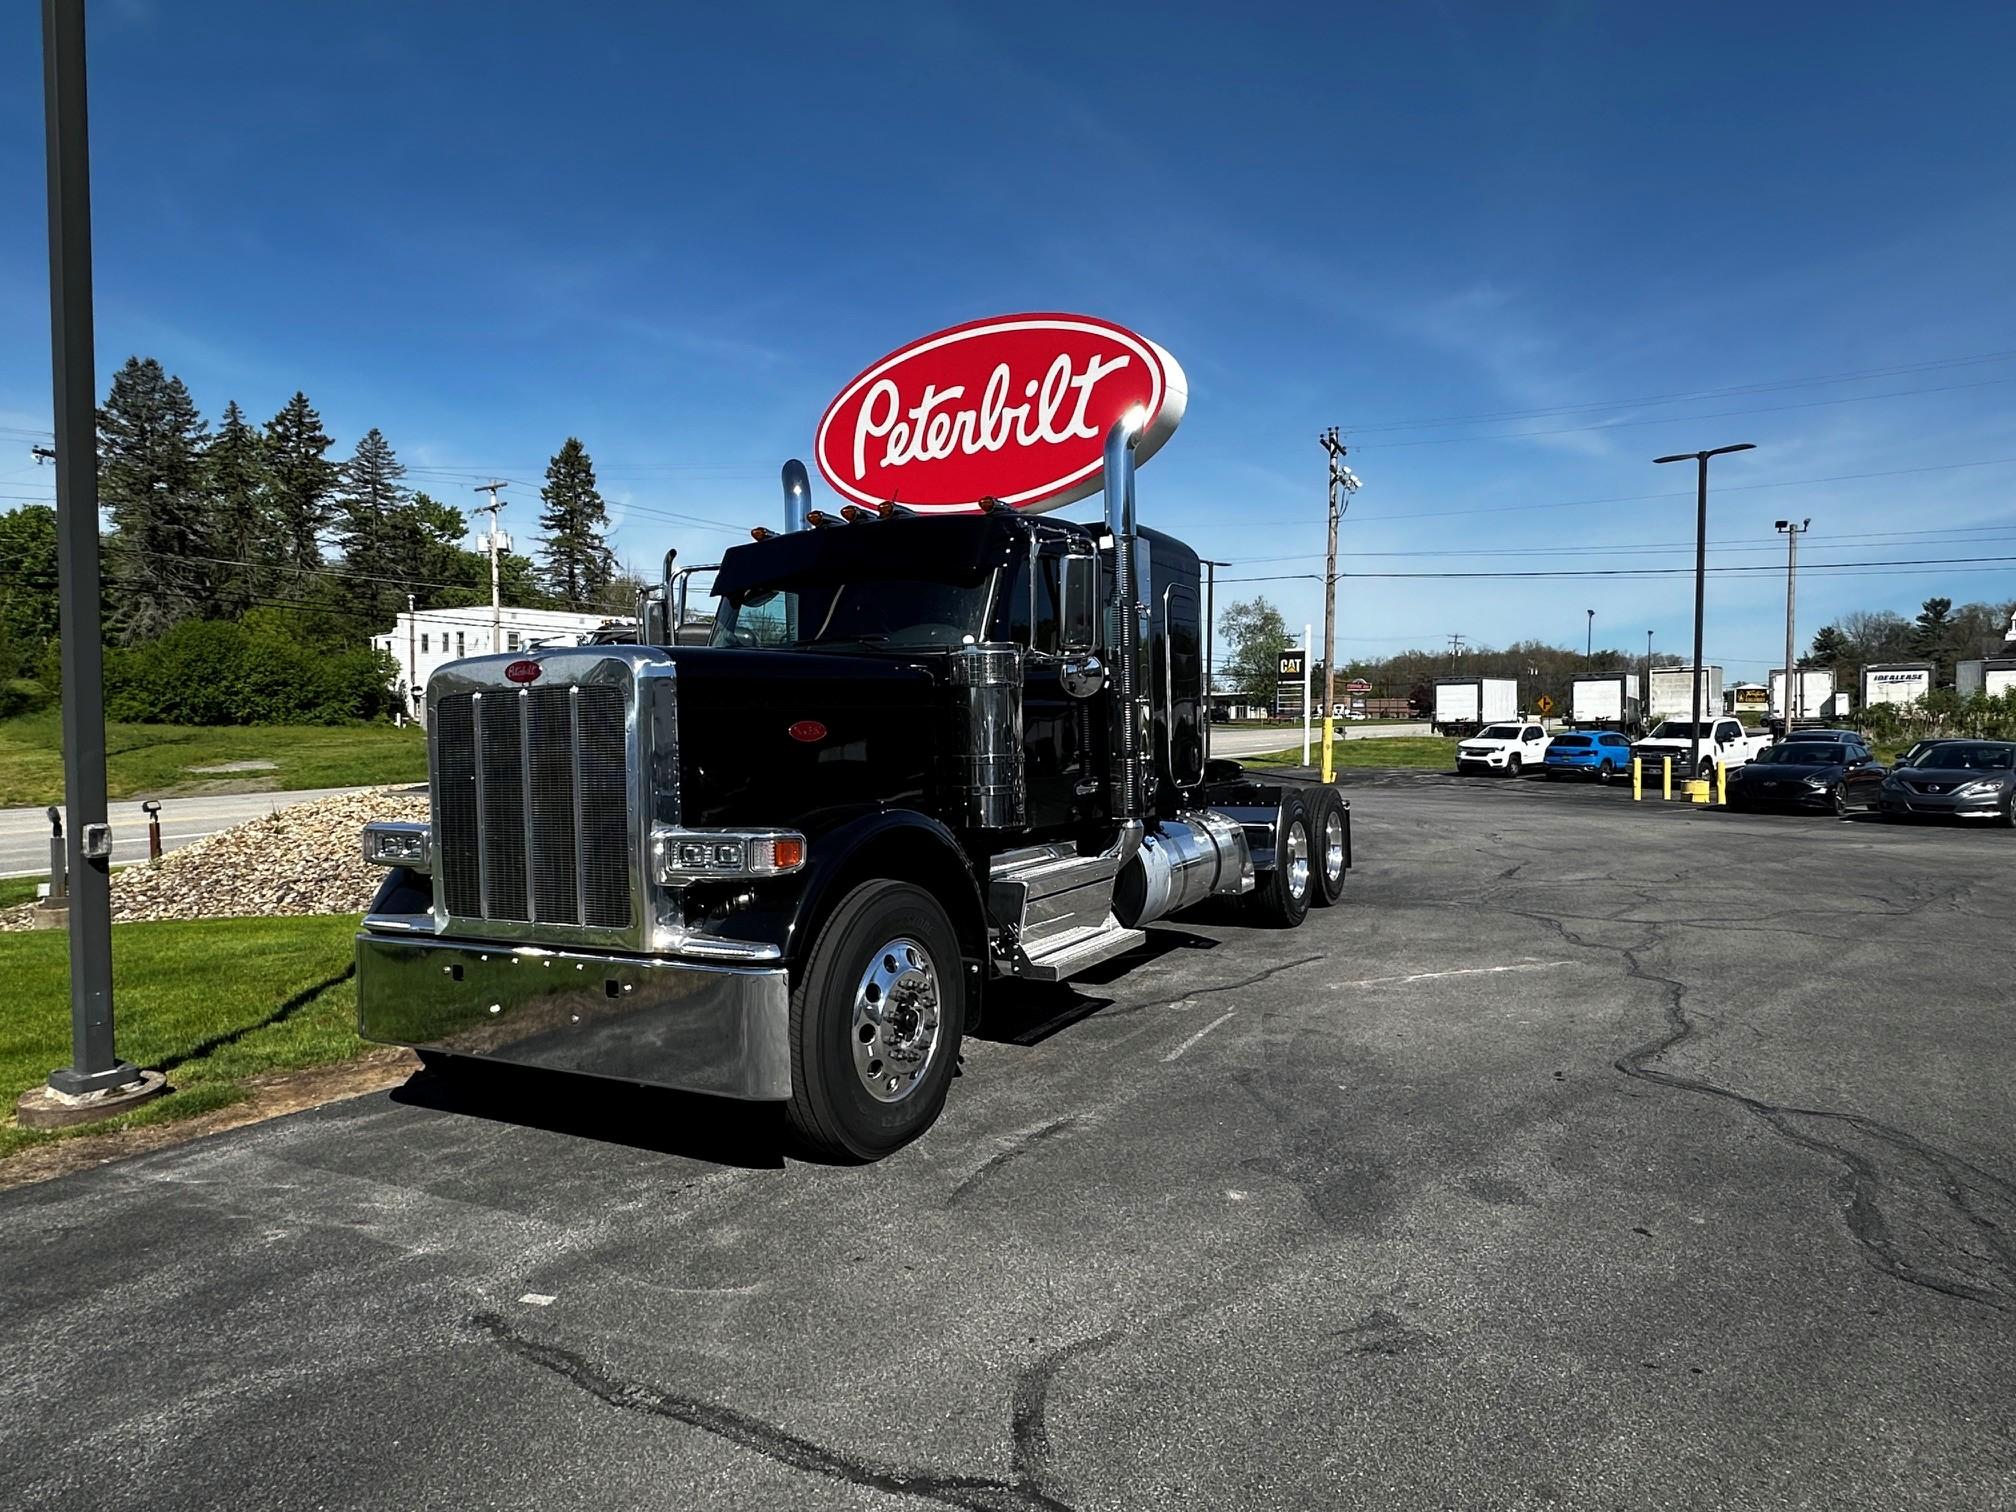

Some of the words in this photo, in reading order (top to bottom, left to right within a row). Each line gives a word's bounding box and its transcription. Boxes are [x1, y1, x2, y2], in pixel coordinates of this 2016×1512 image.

[853, 353, 1131, 481] Peterbilt
[1280, 659, 1302, 674] CAT
[1873, 673, 1924, 681] IDEALEASE
